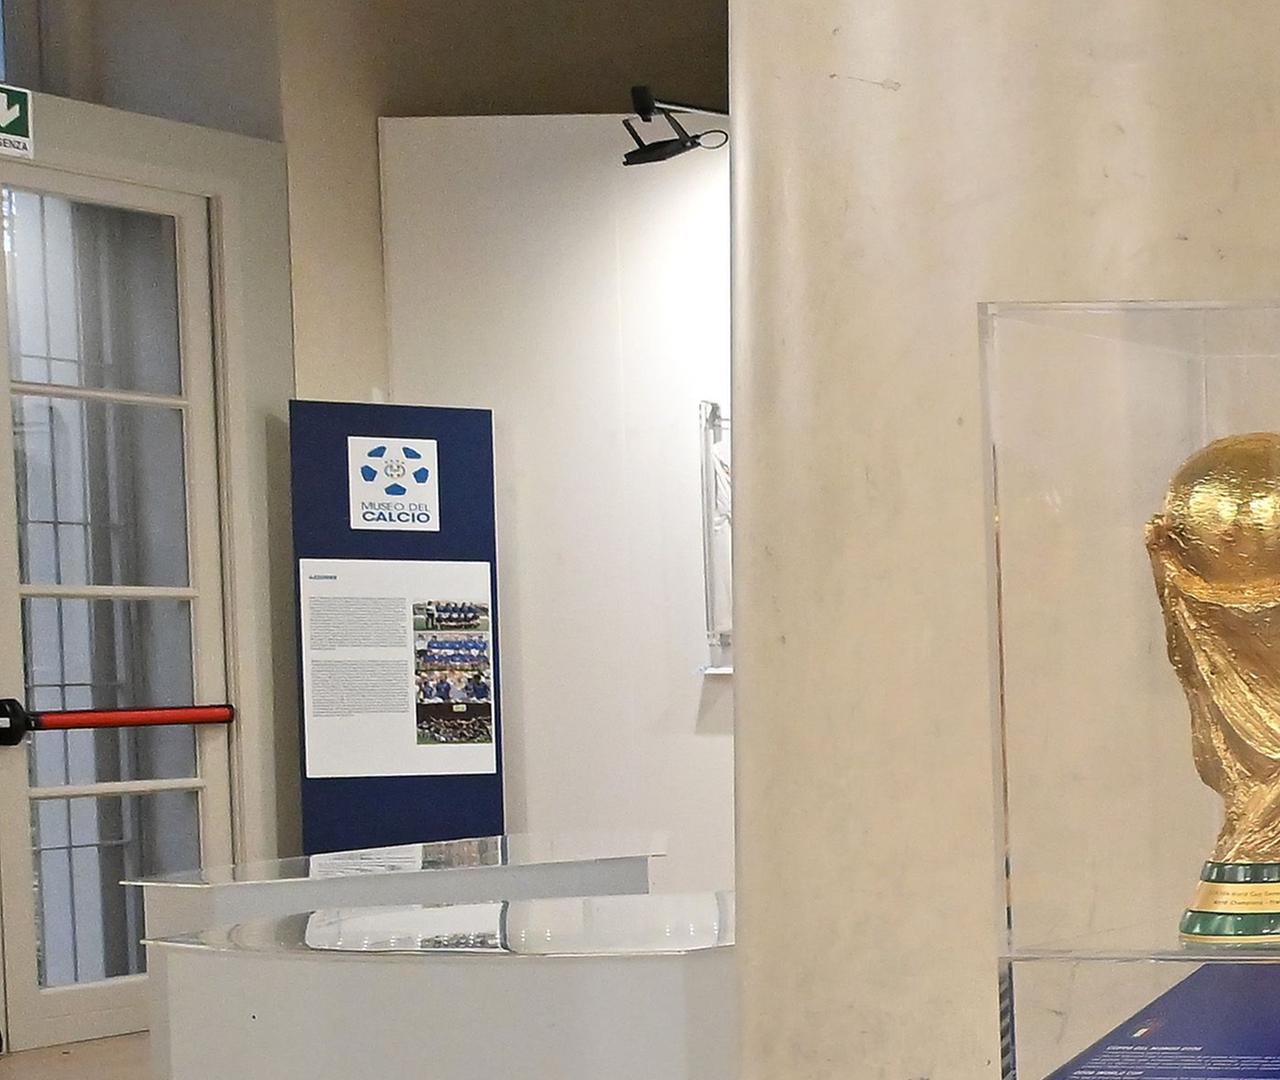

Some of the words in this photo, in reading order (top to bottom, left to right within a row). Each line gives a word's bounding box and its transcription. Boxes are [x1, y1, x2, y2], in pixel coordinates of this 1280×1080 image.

[361, 502, 405, 511] MUSEO
[409, 503, 430, 512] DEL
[362, 511, 430, 523] CALCIO
